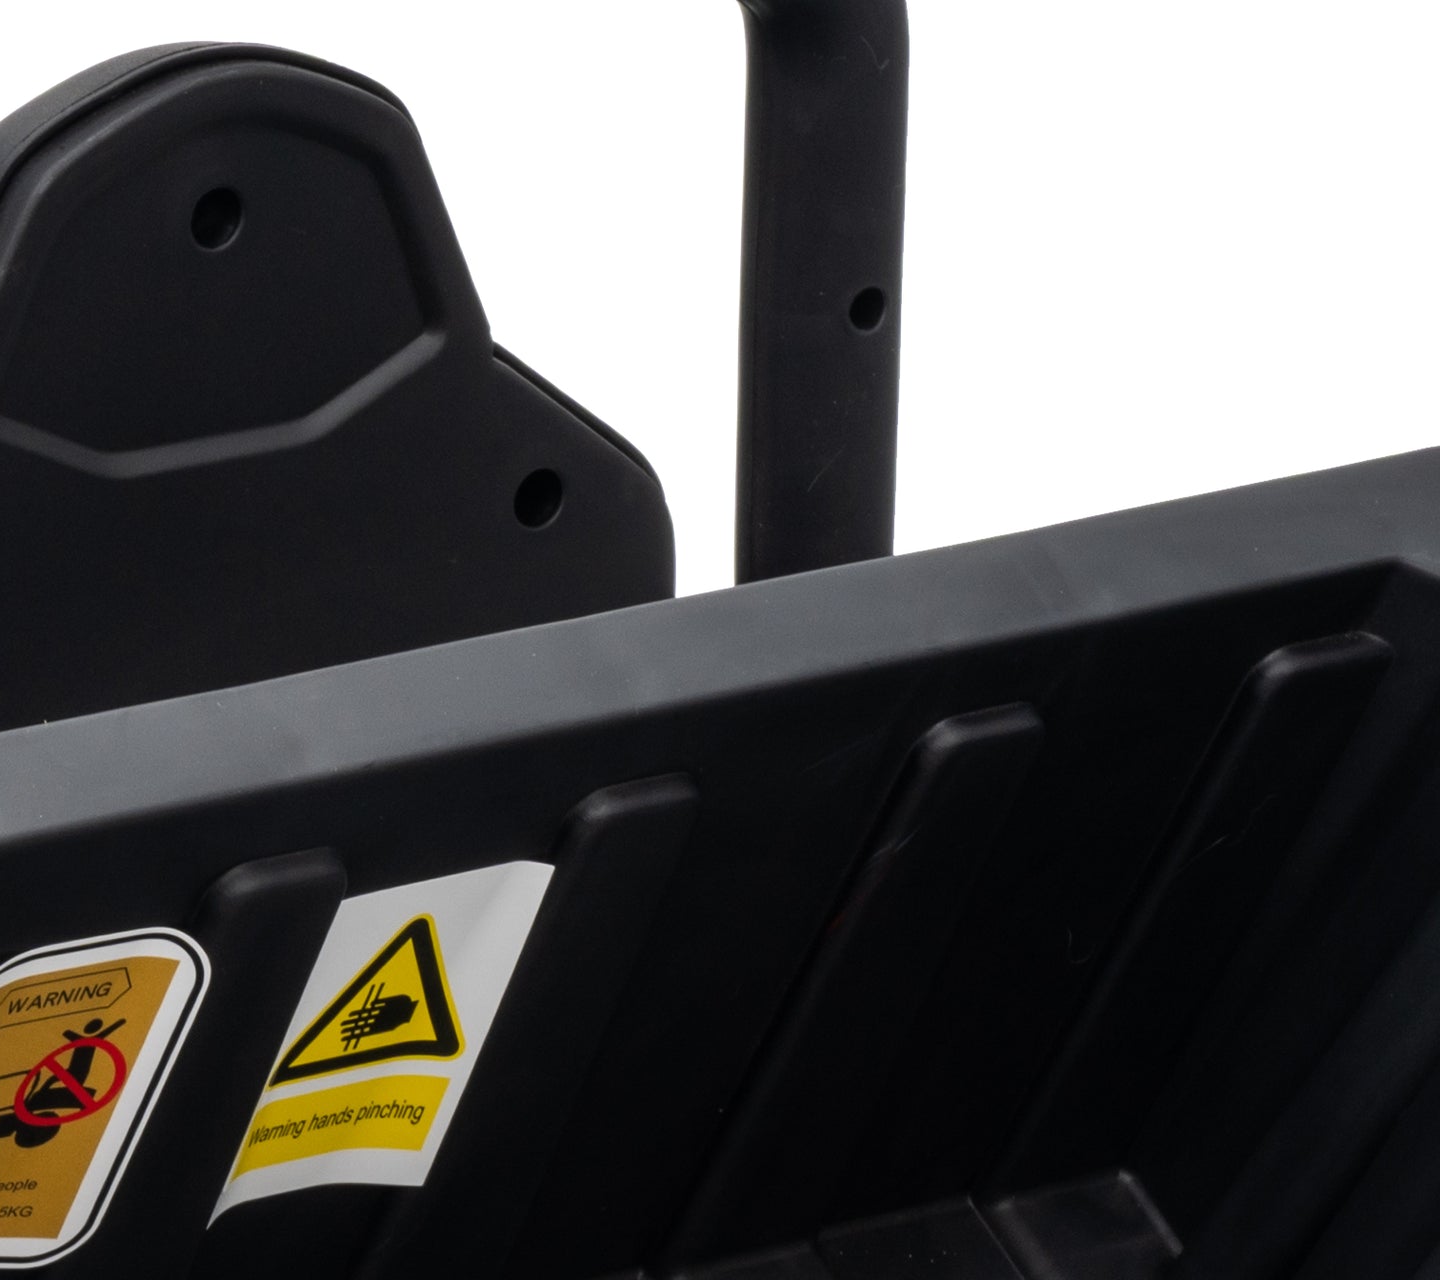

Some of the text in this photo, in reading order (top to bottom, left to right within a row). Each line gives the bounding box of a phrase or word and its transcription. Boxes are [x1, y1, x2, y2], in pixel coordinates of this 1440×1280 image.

[8, 981, 113, 1015] WARNING
[248, 1100, 425, 1148] Warning hands pinching
